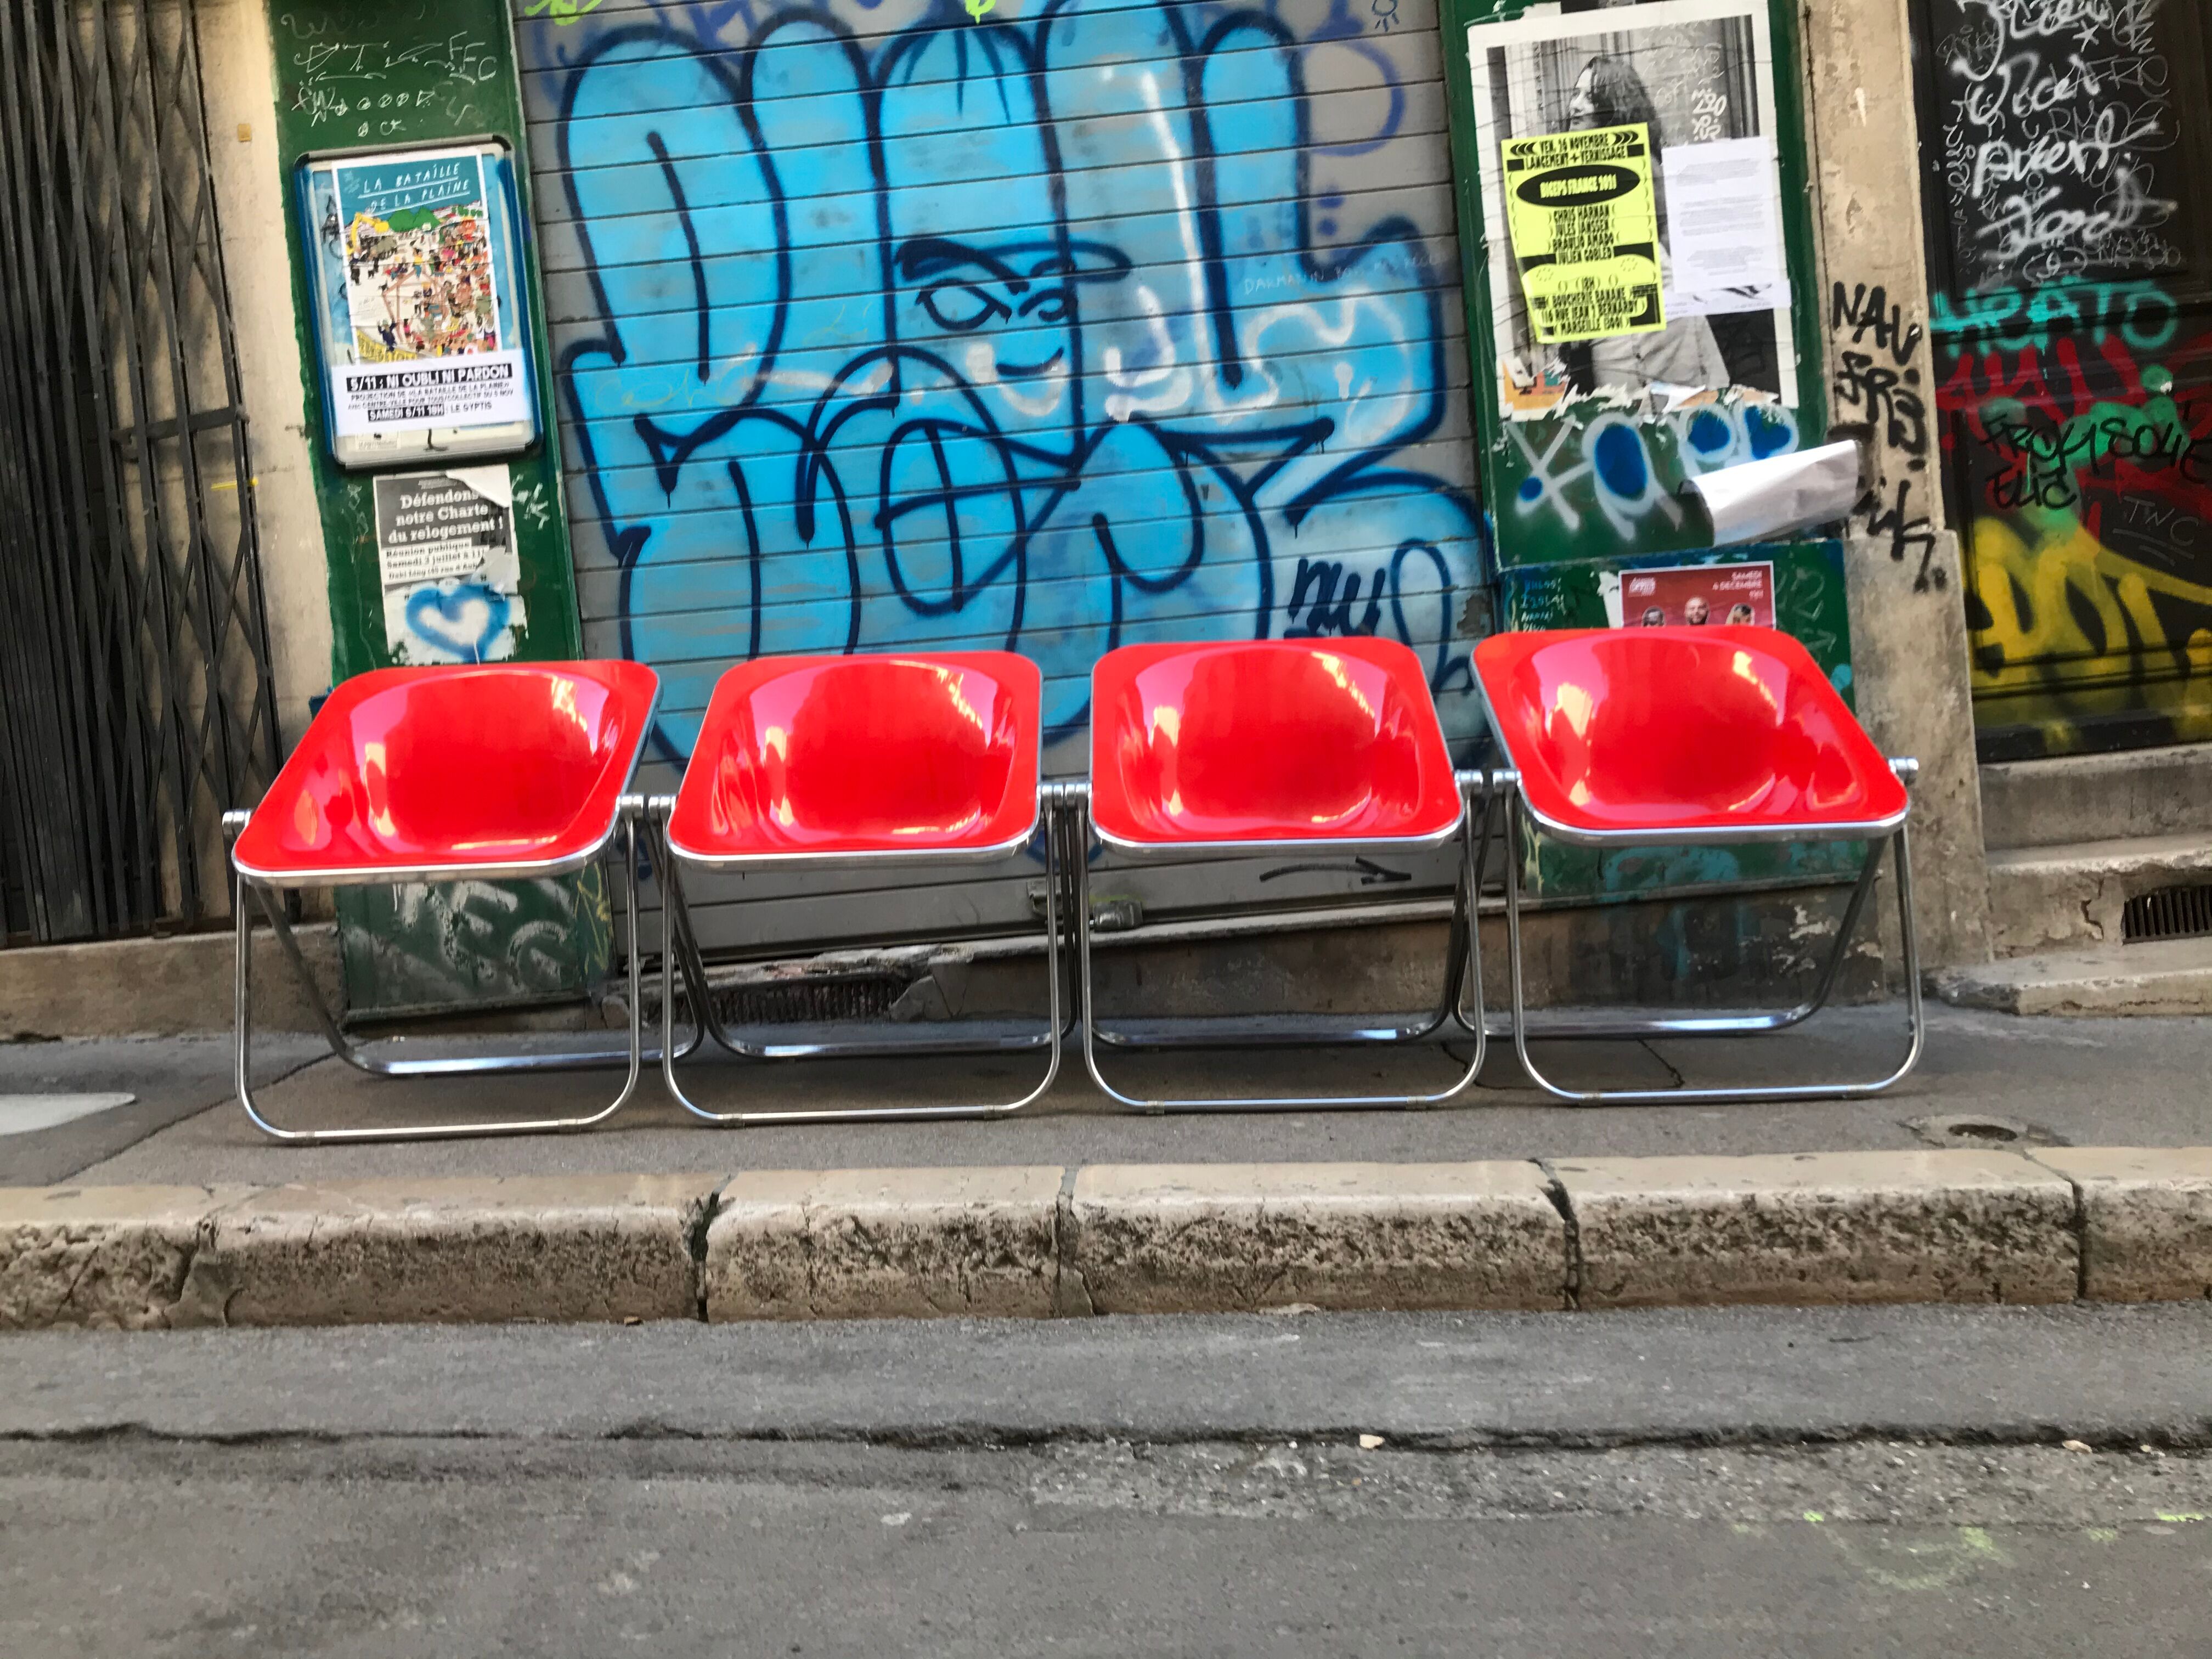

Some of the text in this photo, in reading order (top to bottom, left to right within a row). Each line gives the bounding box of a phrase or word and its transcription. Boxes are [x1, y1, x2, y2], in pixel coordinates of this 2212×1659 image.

[1569, 133, 1609, 149] NOVEMBRE
[1526, 153, 1568, 170] LANCEMENT
[1581, 145, 1626, 164] VERNISSAGE
[364, 162, 461, 193] LA BATAILLE
[1567, 176, 1599, 195] FRANCE
[370, 179, 470, 215] DE LA PLAINE
[351, 376, 376, 391] 5/11
[386, 374, 399, 389] NI
[402, 370, 439, 388] OUBLI
[442, 369, 455, 383] NI
[458, 364, 509, 382] PARDON
[370, 408, 403, 421] SAMEDI
[451, 404, 460, 413] LE
[400, 488, 479, 509] Défendons
[396, 503, 489, 527] notre Charte
[388, 529, 408, 544] du
[410, 516, 495, 540] relogement
[386, 556, 422, 569] Samedi
